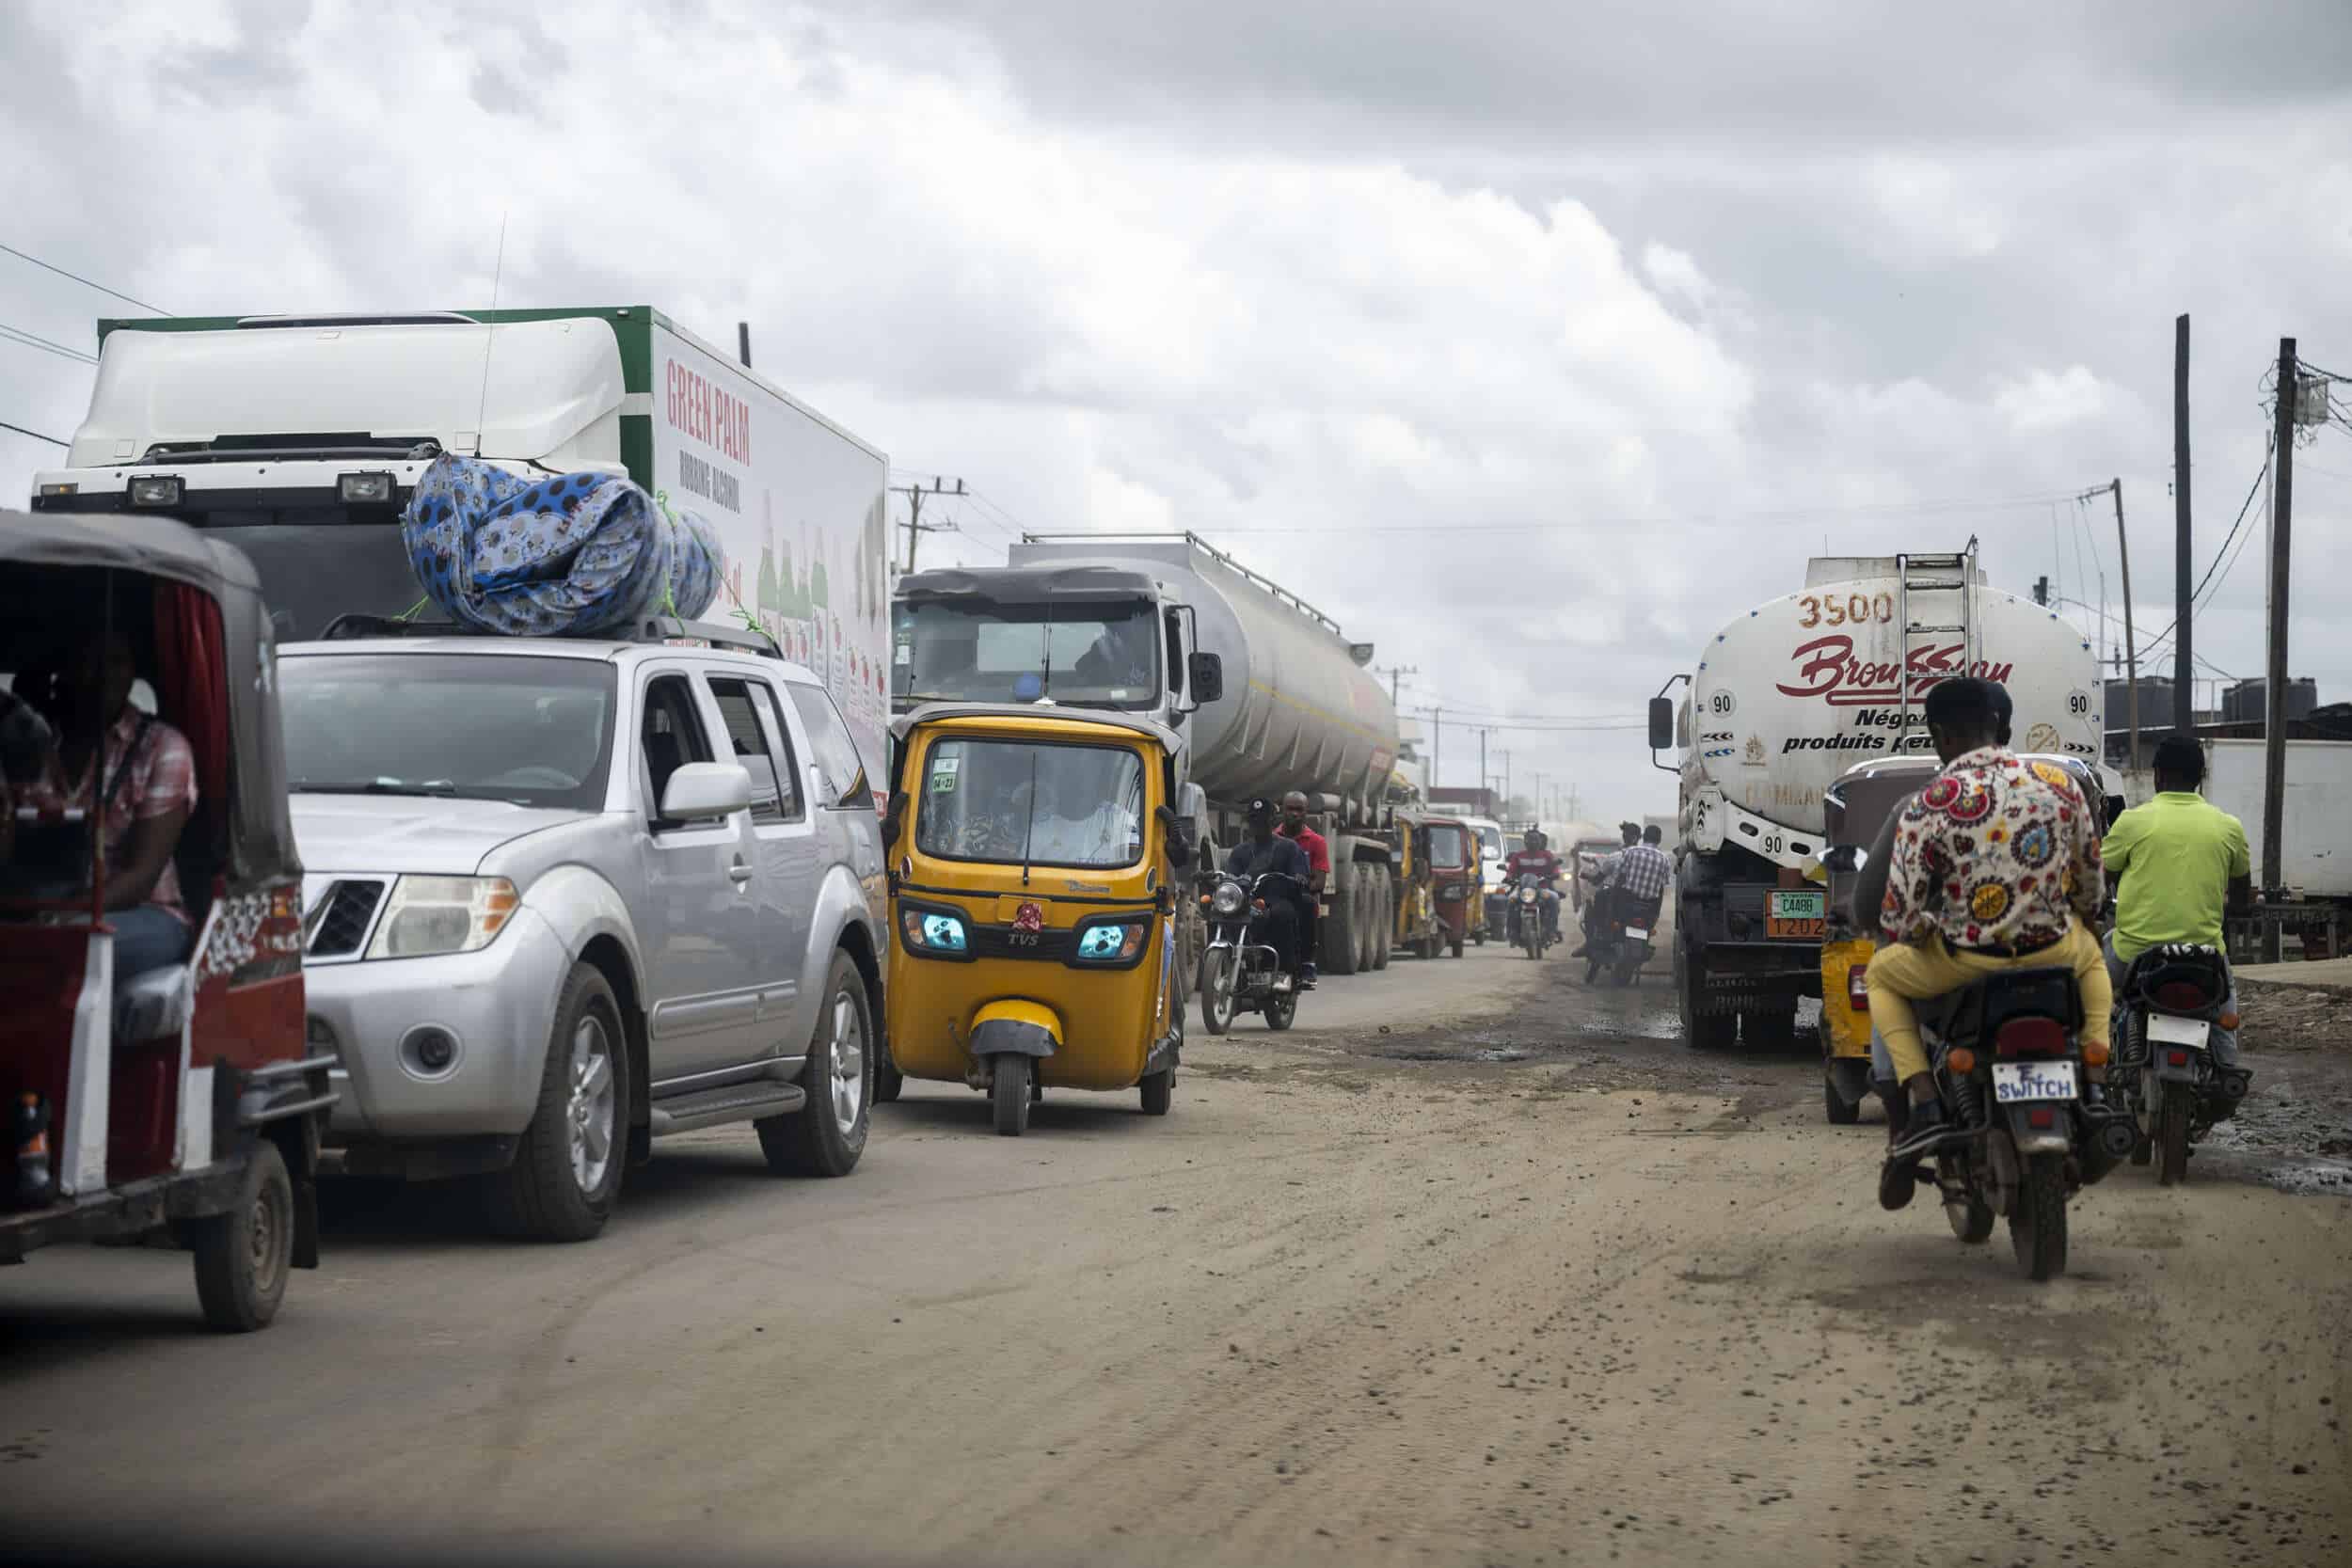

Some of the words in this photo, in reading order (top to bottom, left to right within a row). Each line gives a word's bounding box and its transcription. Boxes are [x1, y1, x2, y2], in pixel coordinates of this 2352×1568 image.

[666, 357, 712, 447] GREEN
[714, 387, 751, 467] PALM
[1798, 592, 1893, 628] 3500
[1713, 694, 1732, 713] 90
[2070, 694, 2088, 713] 90
[1781, 733, 1886, 753] produits
[1764, 835, 1783, 854] 90
[1008, 933, 1040, 946] TVS
